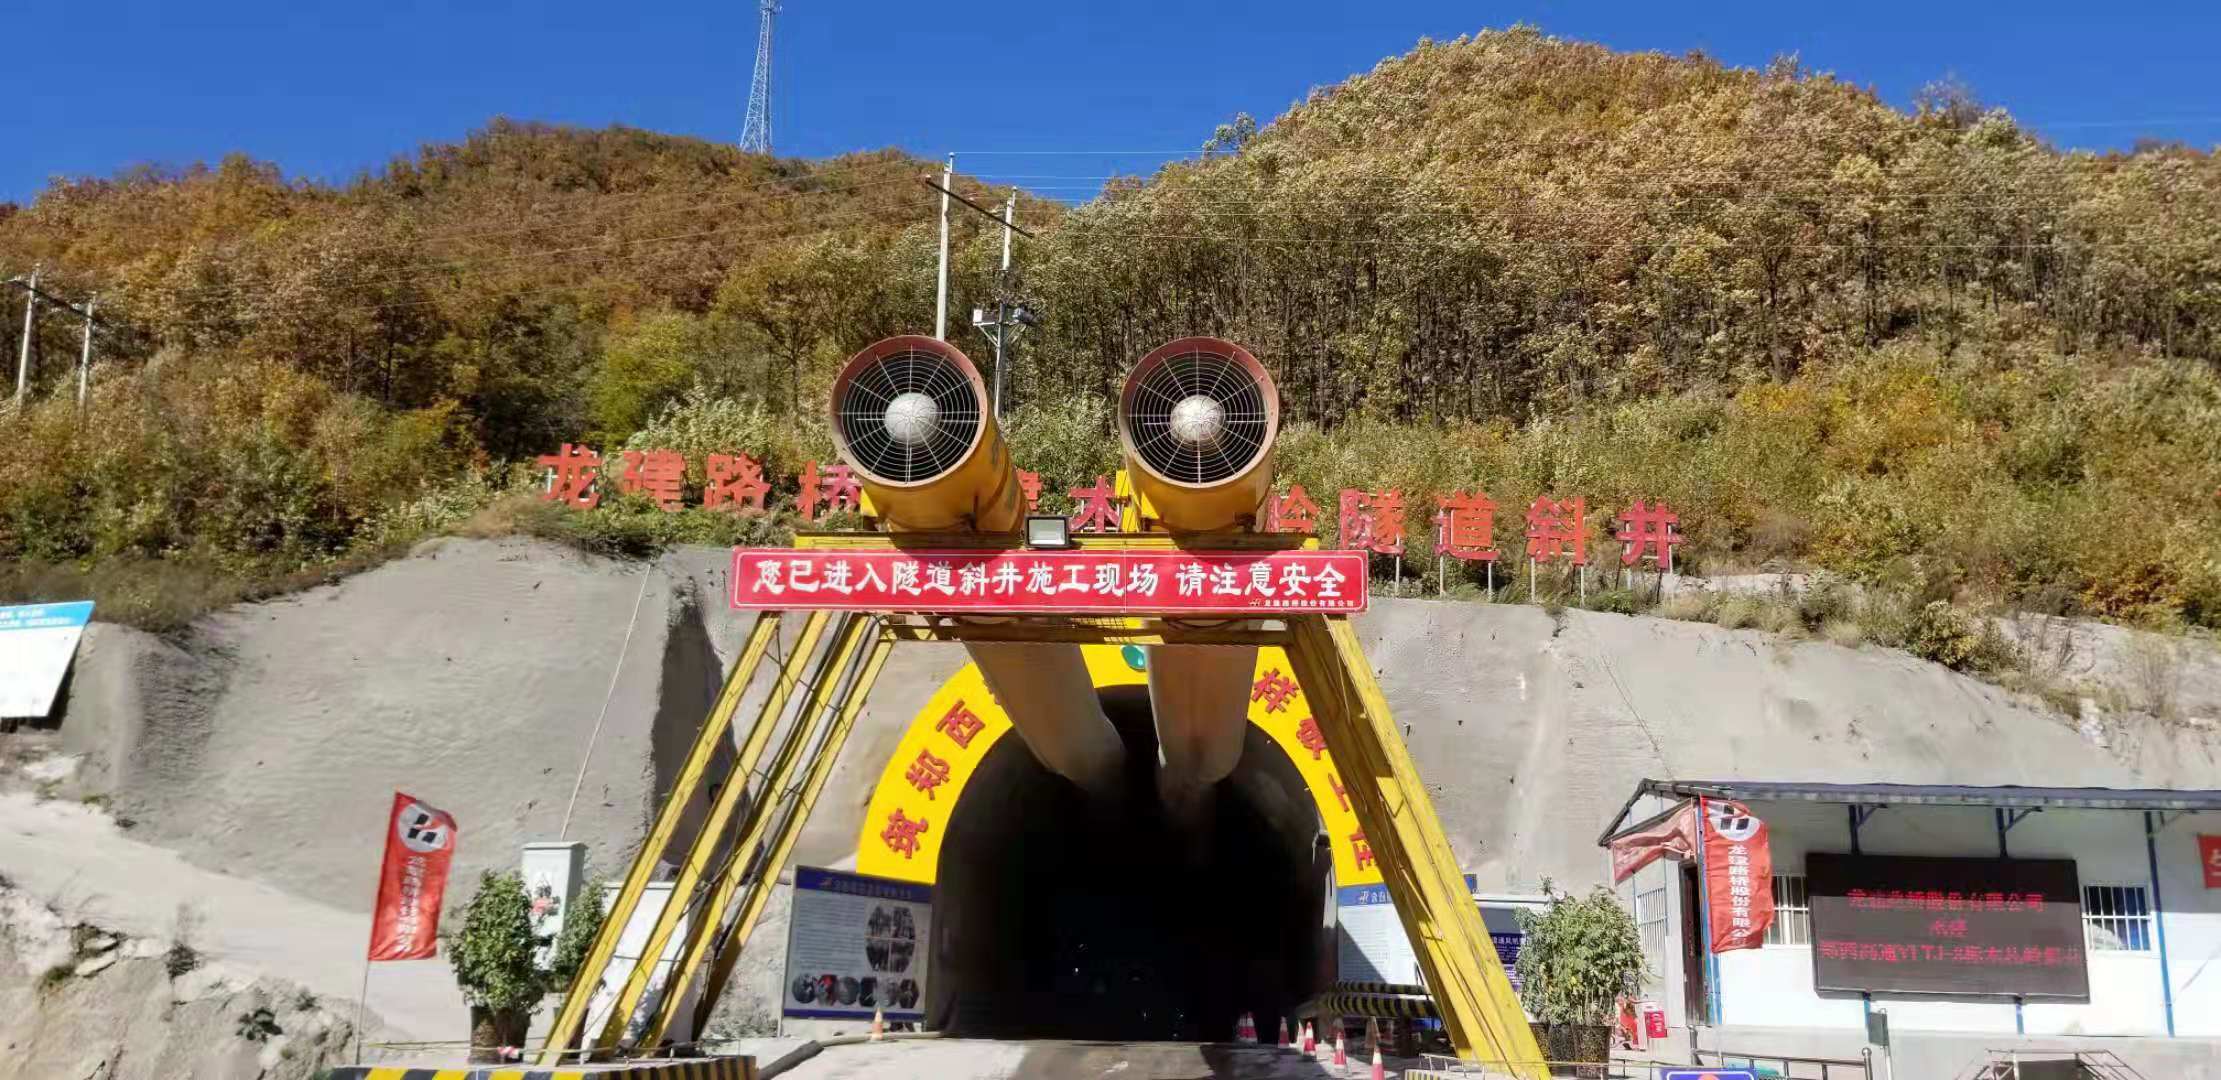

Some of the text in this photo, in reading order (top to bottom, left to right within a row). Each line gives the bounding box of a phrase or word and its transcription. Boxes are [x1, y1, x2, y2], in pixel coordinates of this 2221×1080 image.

[752, 559, 1347, 598] 您已进入隧道斜井施工现场 请注意安全
[880, 699, 986, 860] 筑郑西
